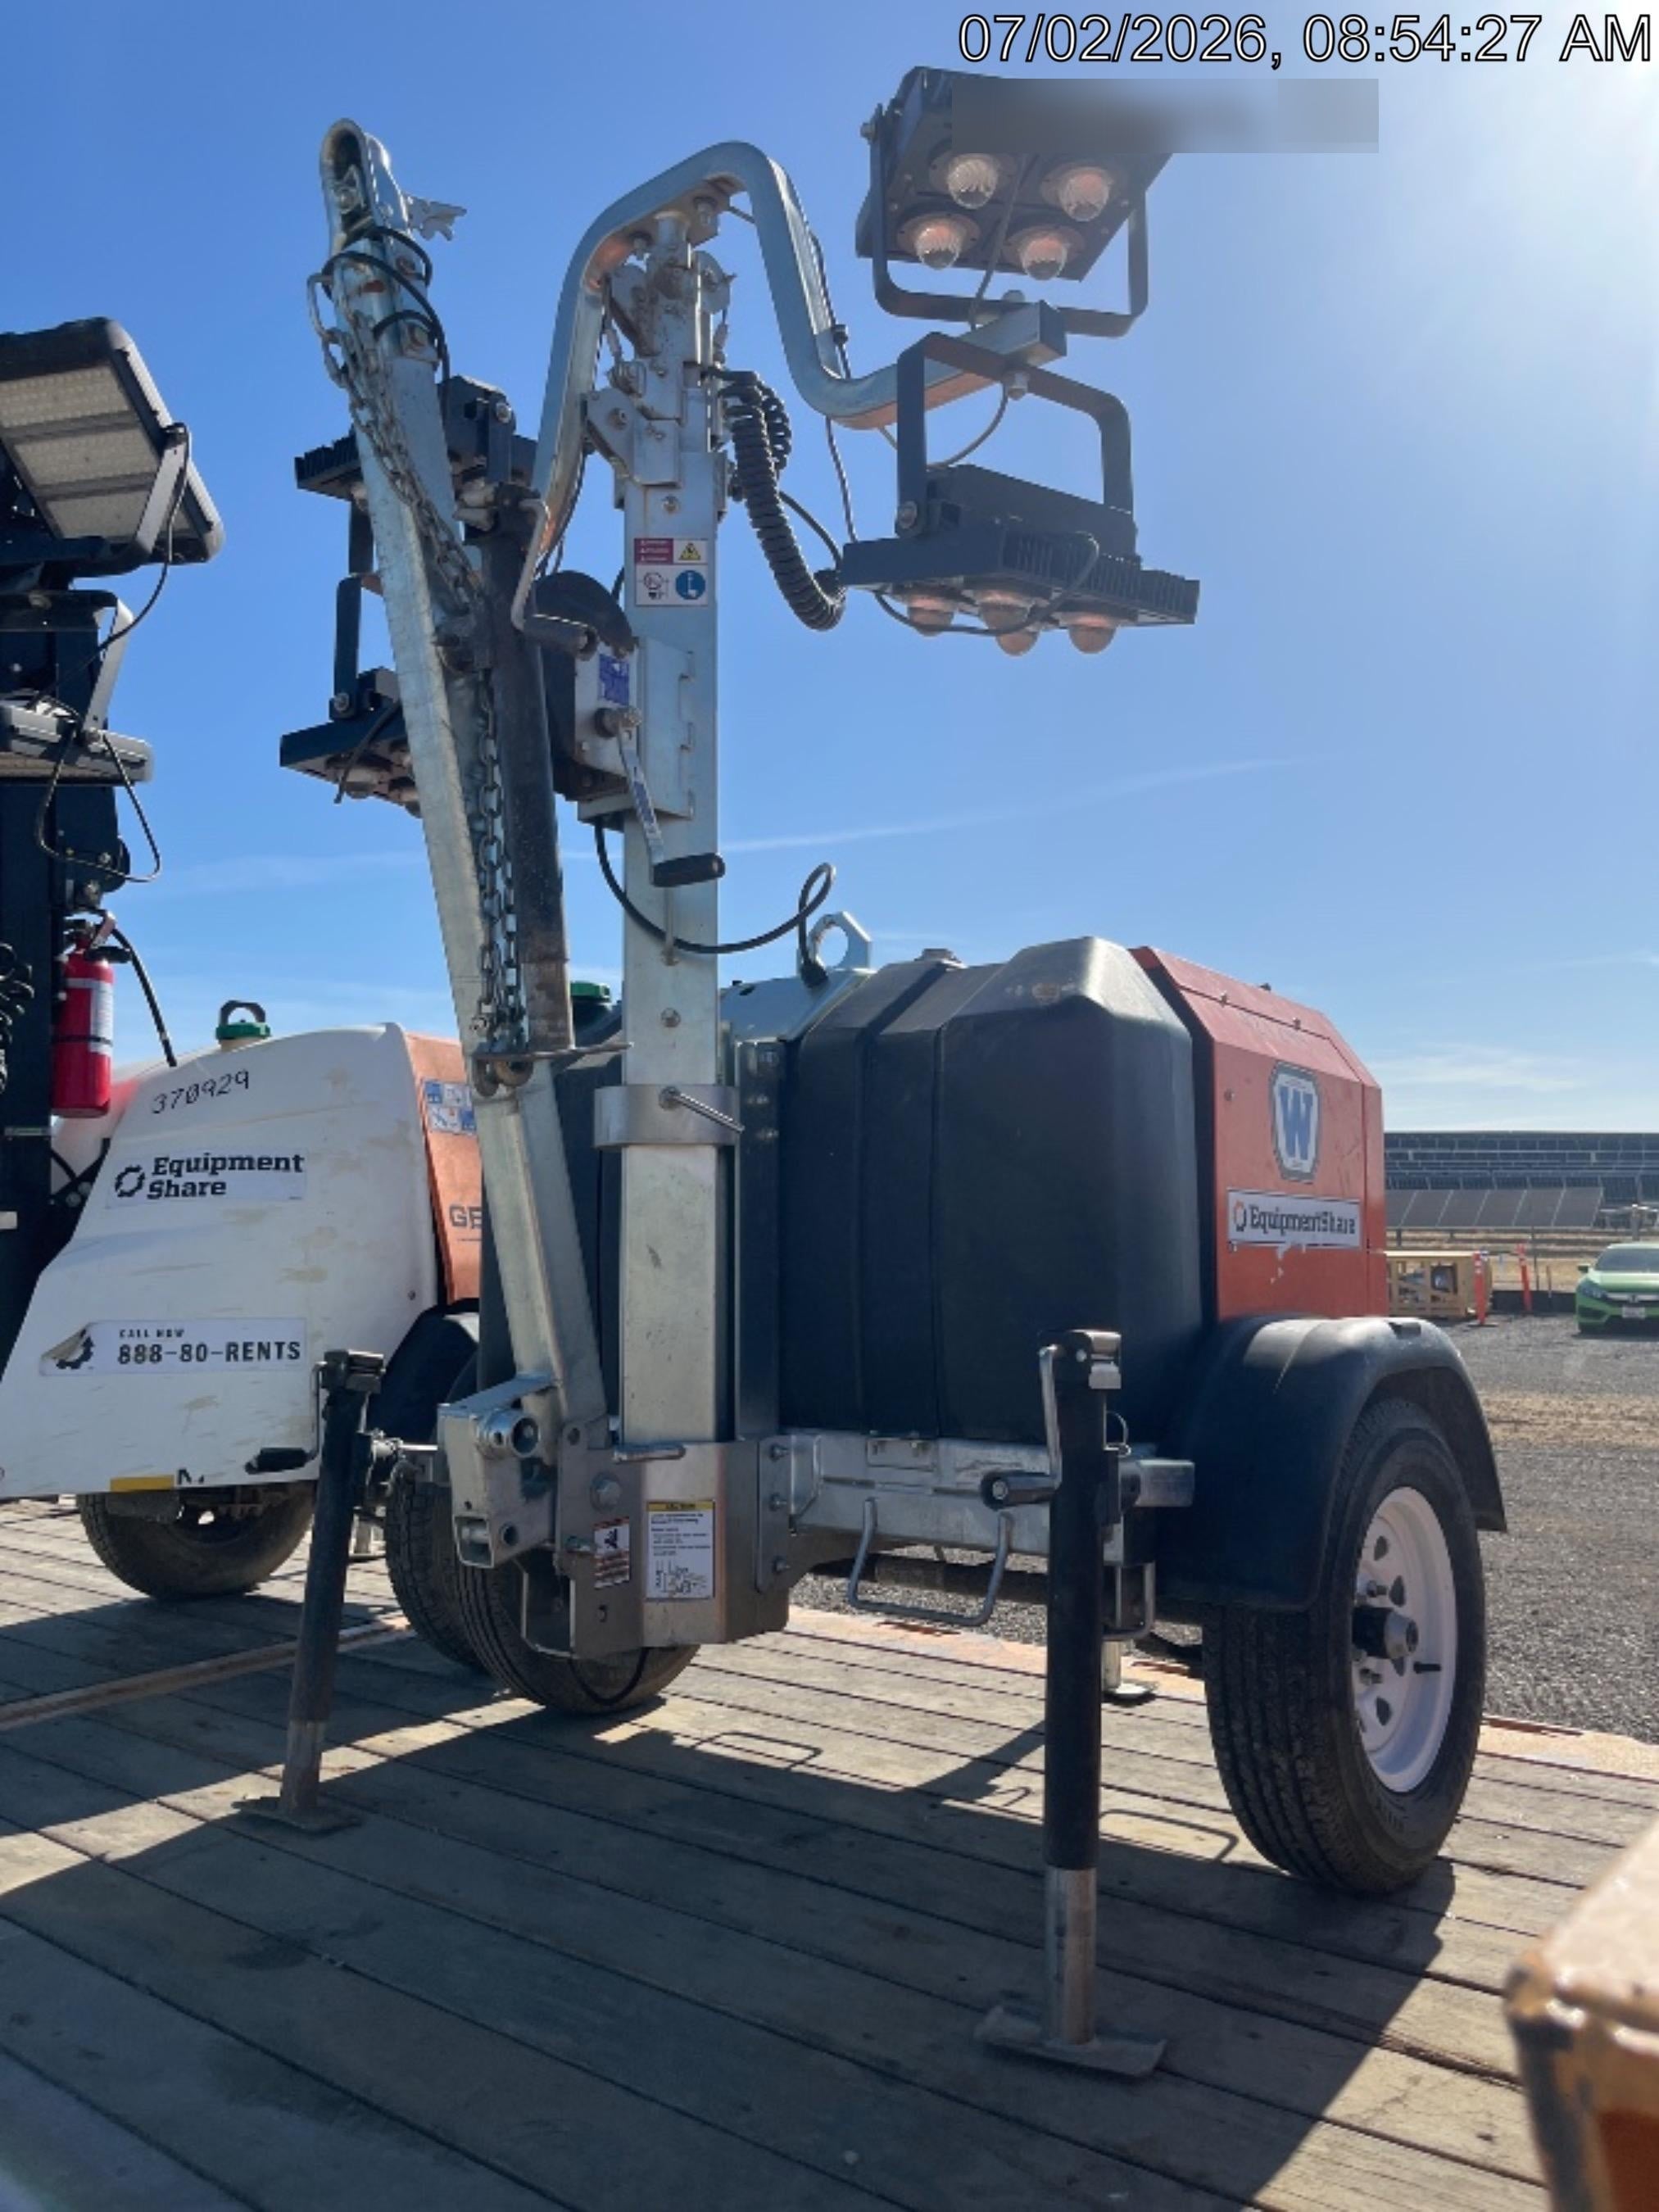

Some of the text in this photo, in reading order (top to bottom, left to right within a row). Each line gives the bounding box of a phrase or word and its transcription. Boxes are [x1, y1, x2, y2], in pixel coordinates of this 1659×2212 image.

[152, 1069, 249, 1113] 370929
[1280, 1086, 1313, 1160] W
[152, 1153, 304, 1177] Equipment
[147, 1179, 226, 1199] Share
[1249, 1205, 1356, 1235] EquipmentShare
[117, 1341, 301, 1365] 888-80-RENTS
